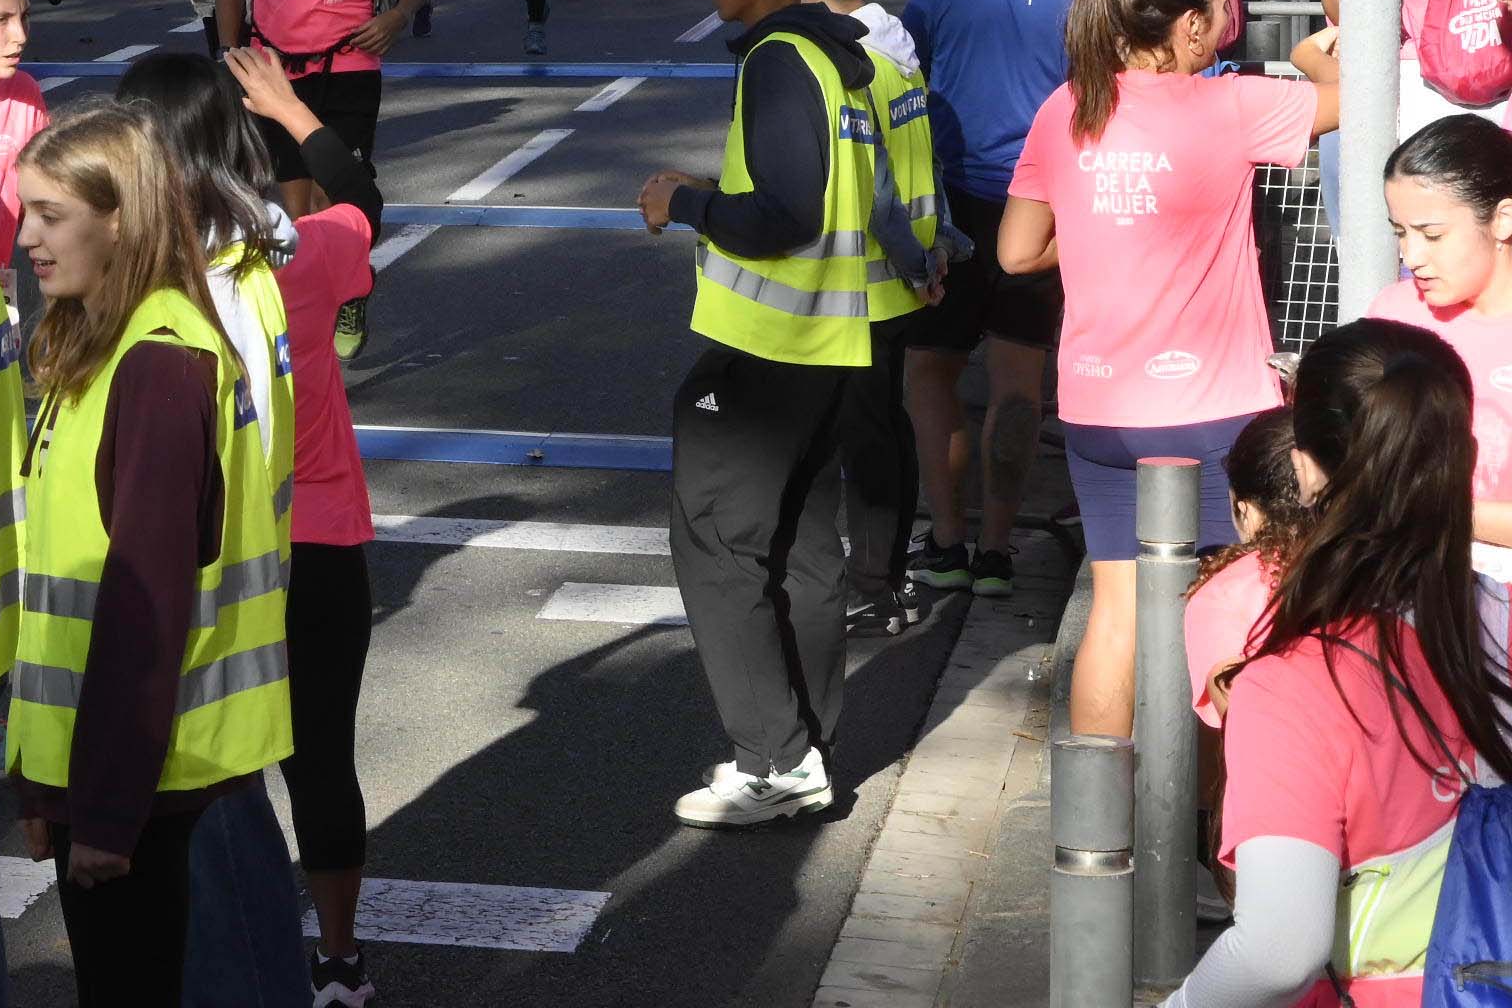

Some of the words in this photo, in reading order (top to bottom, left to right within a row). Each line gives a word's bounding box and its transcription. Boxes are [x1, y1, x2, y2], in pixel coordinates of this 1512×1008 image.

[1078, 150, 1173, 173] CARRERA
[1095, 173, 1119, 194] DE
[1125, 173, 1153, 193] LA
[1091, 194, 1159, 215] MUJER
[695, 400, 719, 412] adidas
